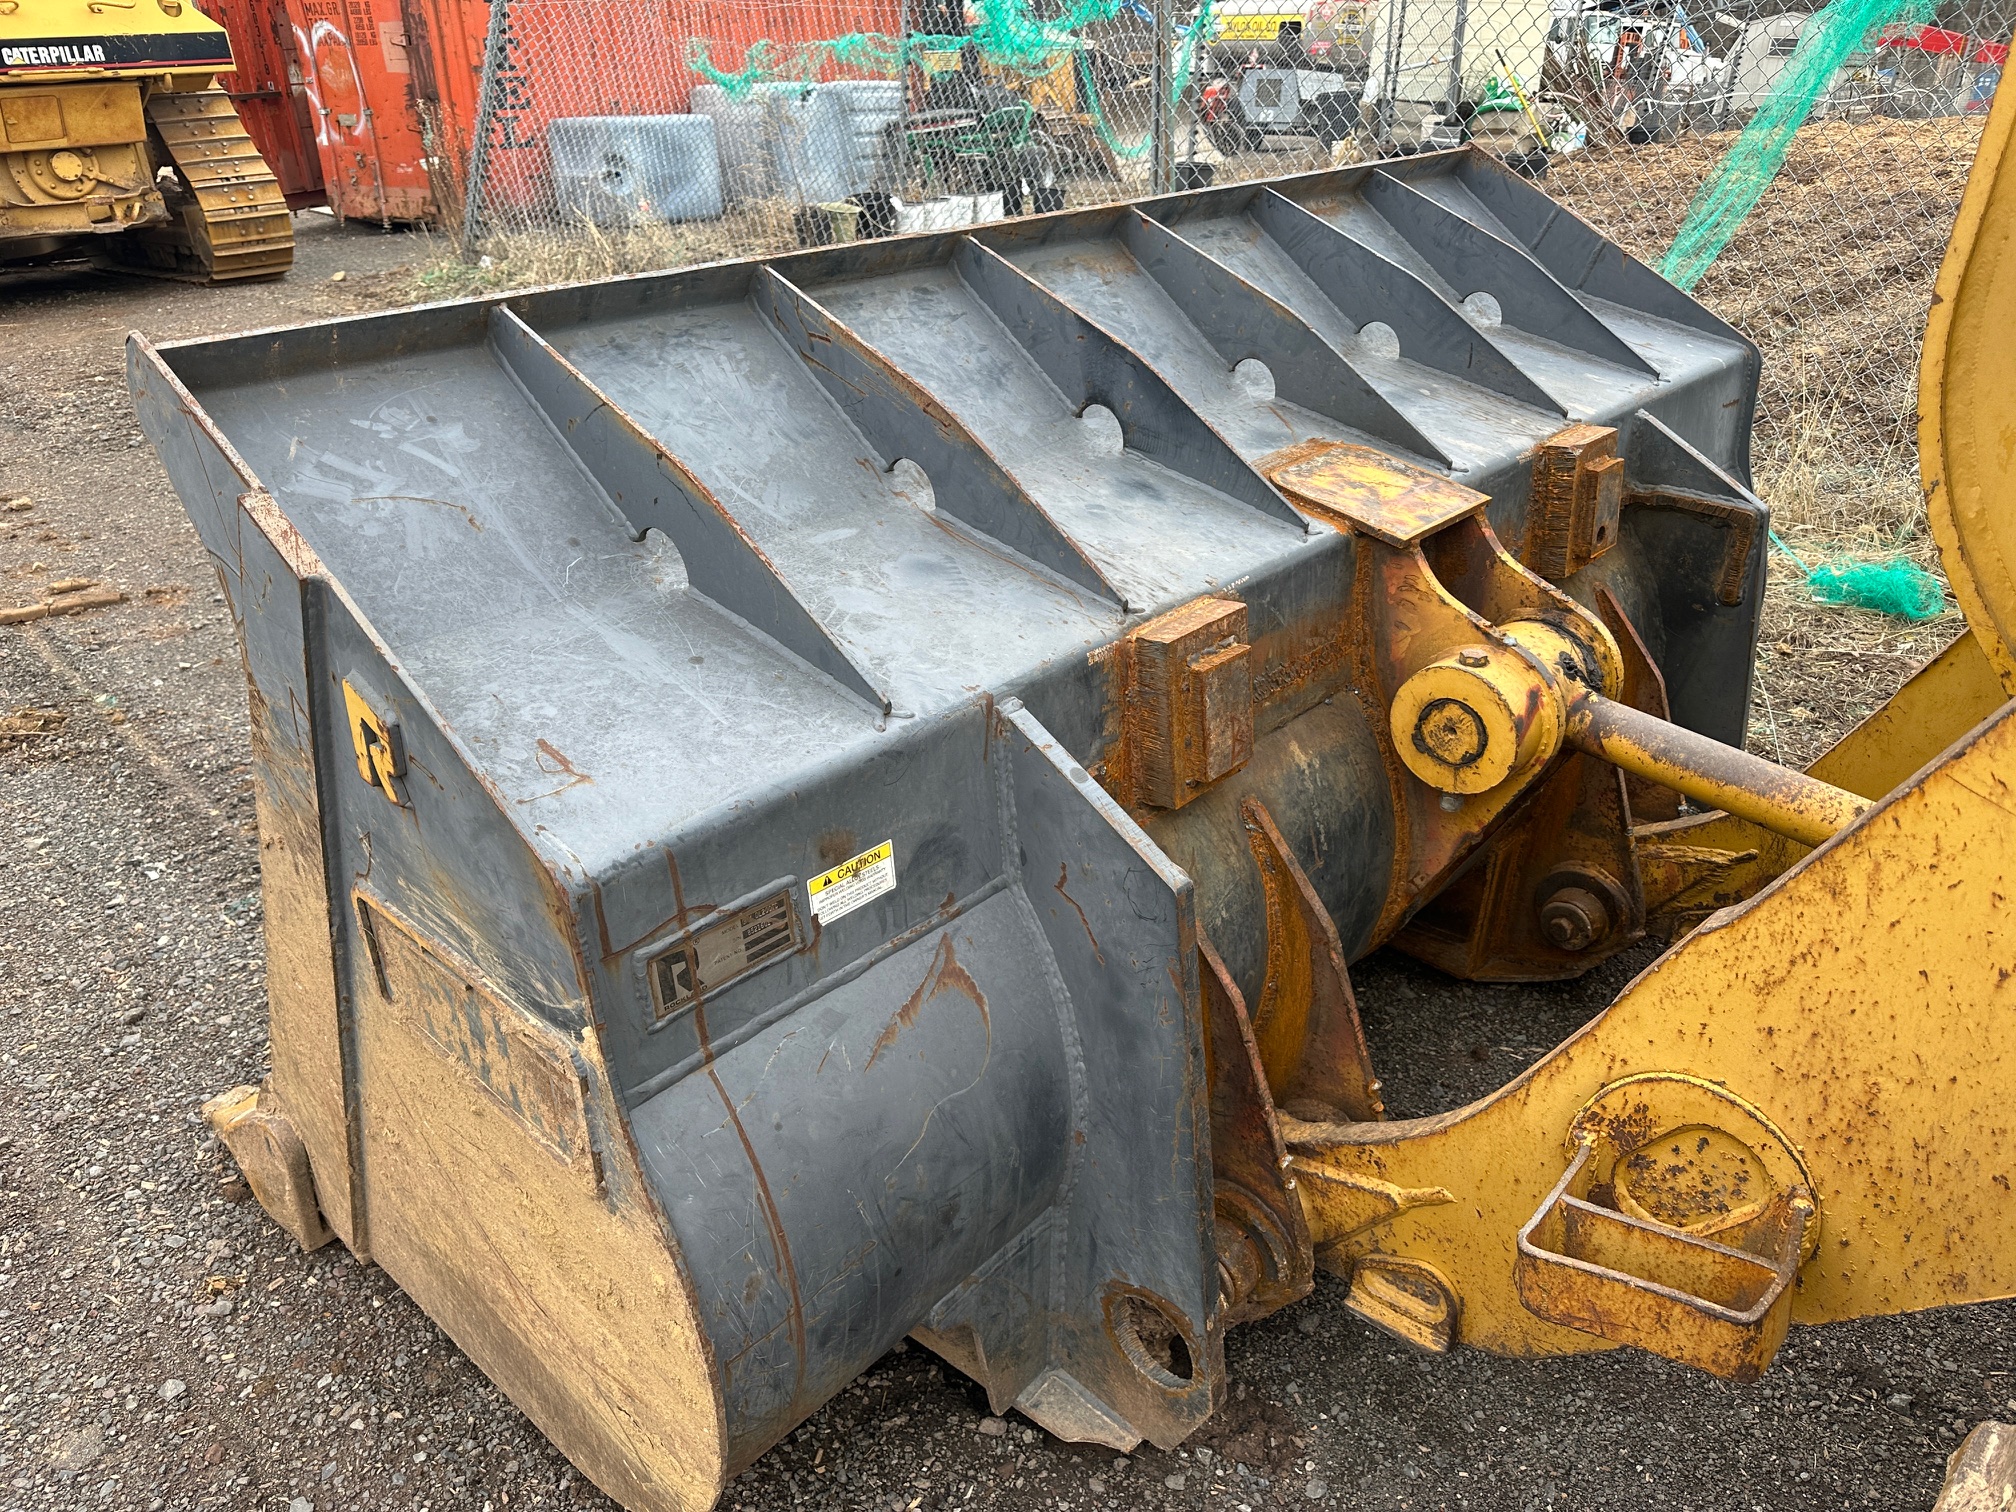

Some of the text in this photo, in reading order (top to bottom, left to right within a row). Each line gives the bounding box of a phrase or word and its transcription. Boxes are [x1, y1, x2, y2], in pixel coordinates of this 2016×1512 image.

[0, 44, 106, 65] CATERPILLAR
[837, 849, 881, 879] CAUTION
[825, 883, 845, 896] SPECIAL
[862, 865, 879, 877] STEELS
[664, 984, 708, 1012] ROCKLD
